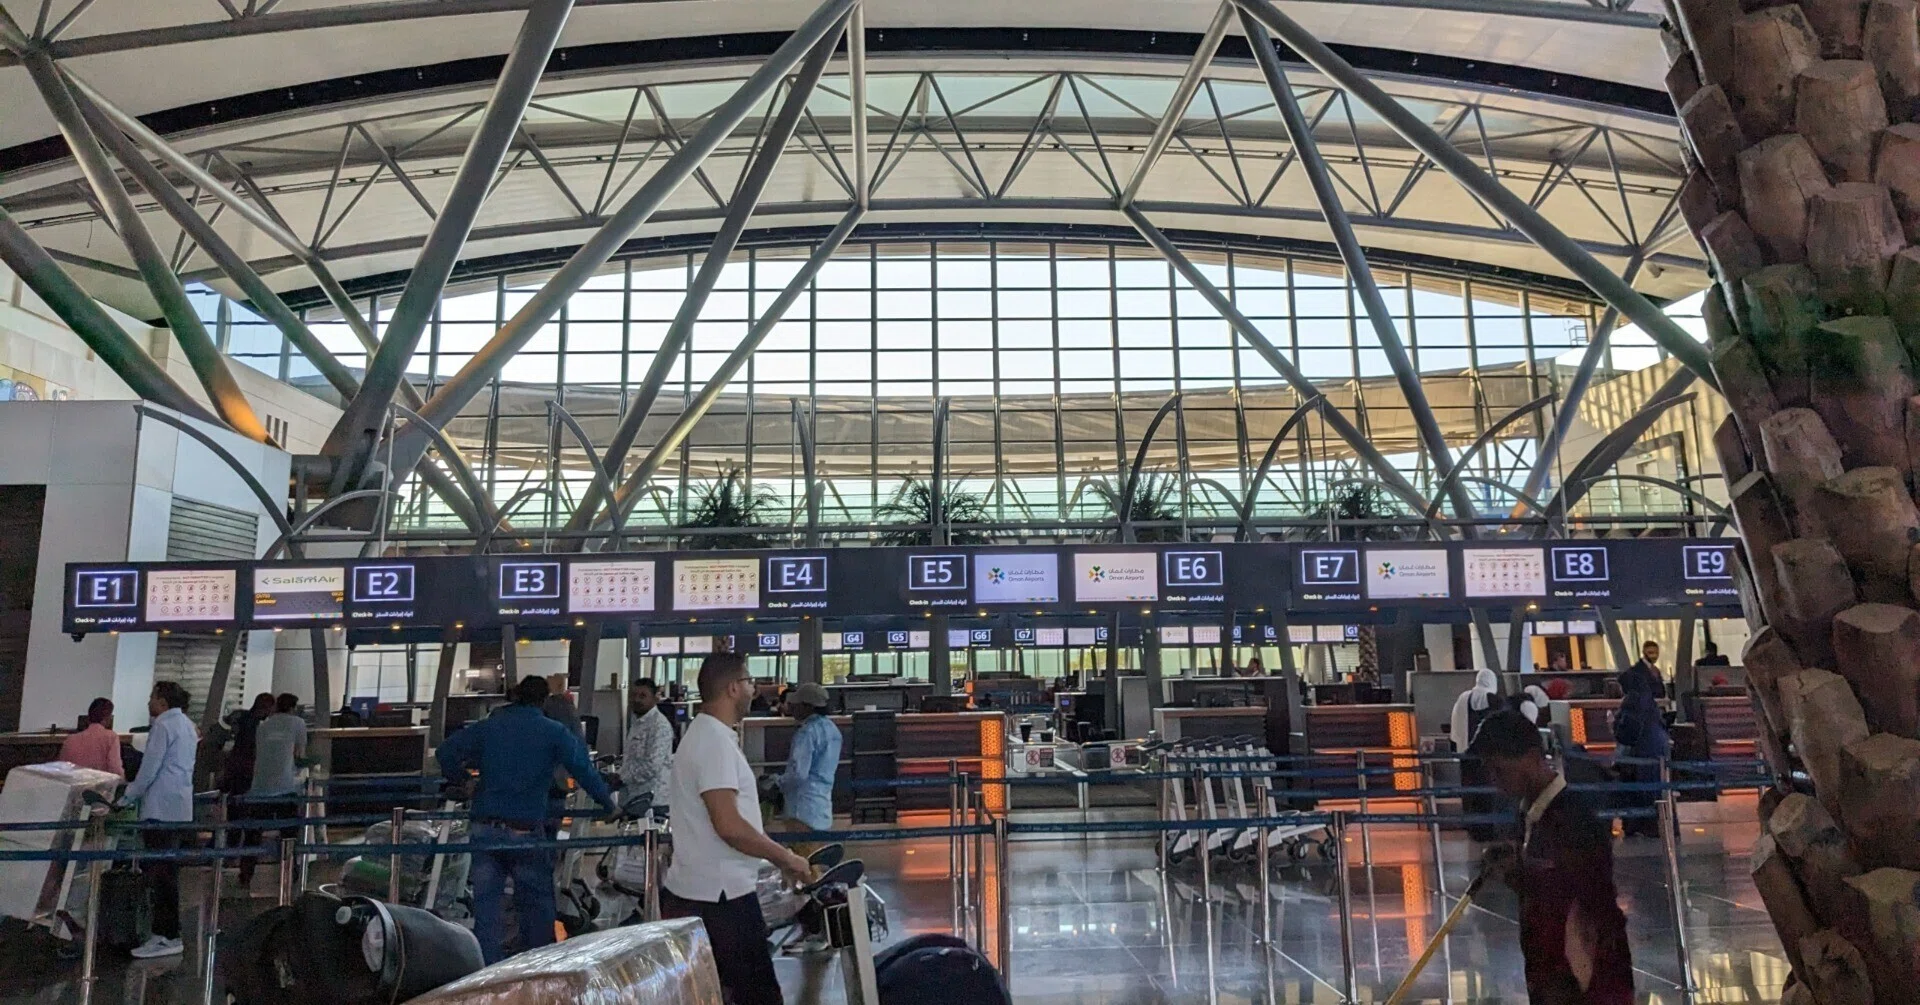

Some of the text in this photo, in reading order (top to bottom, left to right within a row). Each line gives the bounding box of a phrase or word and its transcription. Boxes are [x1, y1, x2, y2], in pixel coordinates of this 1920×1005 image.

[923, 561, 952, 583] E5
[1178, 558, 1206, 580] E6
[1316, 557, 1344, 578] E7
[1565, 553, 1594, 575] E8
[1697, 552, 1725, 573] E9
[368, 572, 398, 595] E2
[515, 570, 545, 592] E3
[782, 563, 812, 586] E4
[94, 578, 120, 600] E1
[763, 636, 776, 644] G3
[974, 631, 987, 639] G6
[1018, 630, 1030, 639] G7
